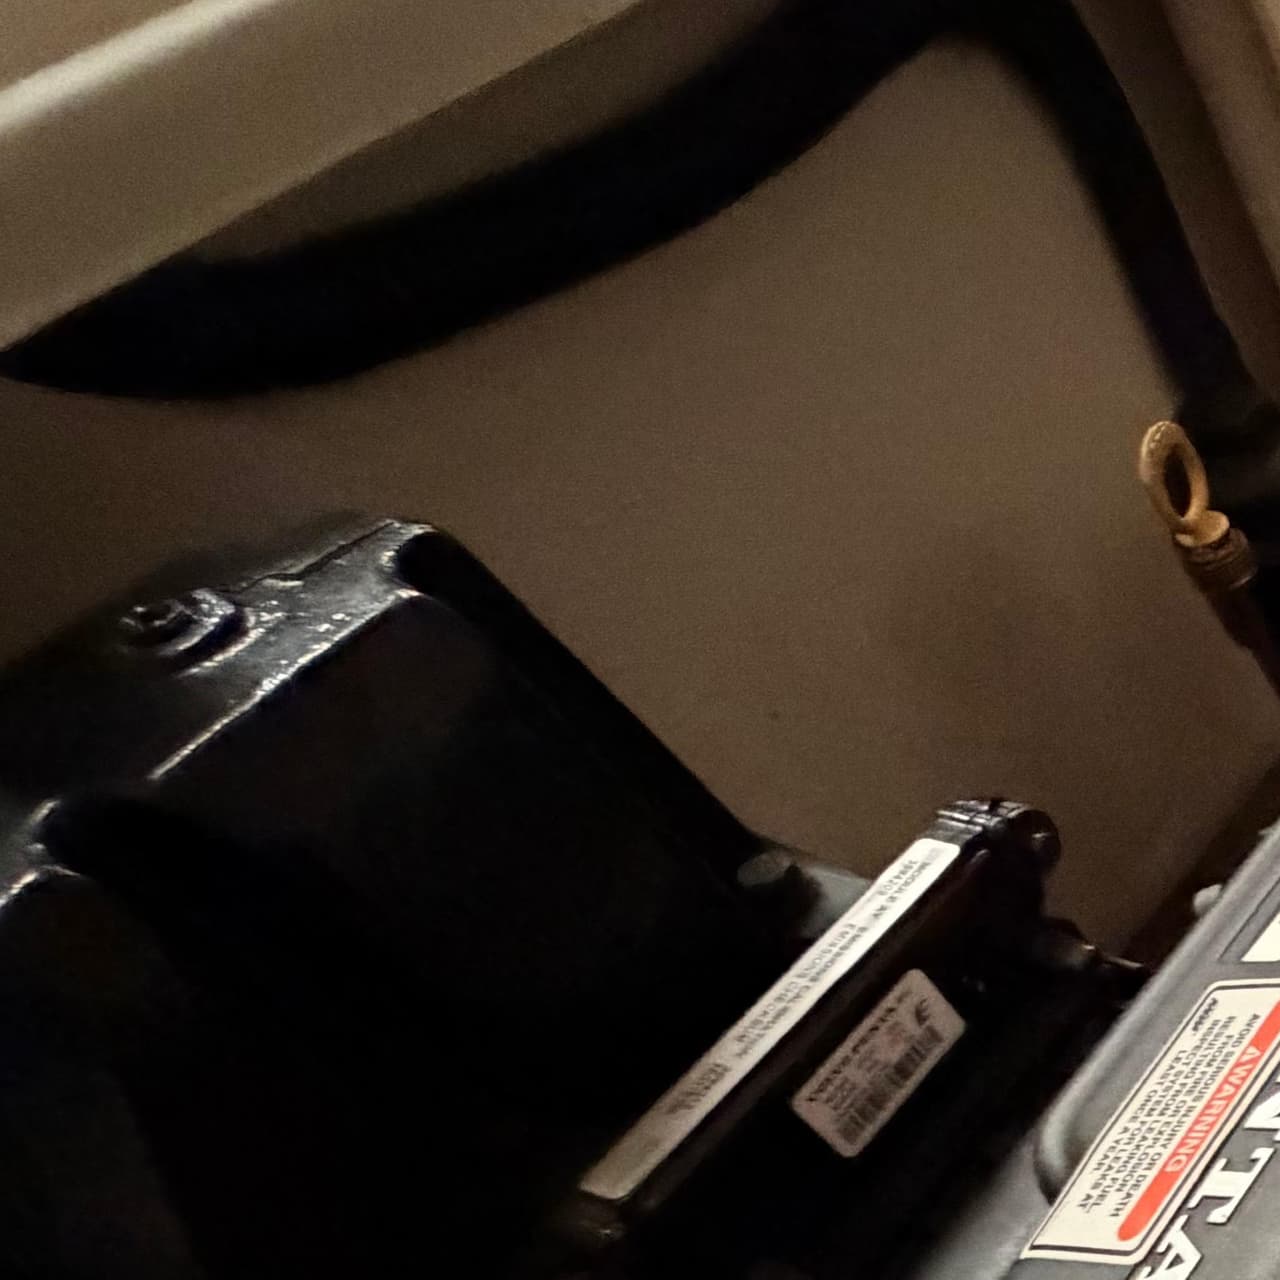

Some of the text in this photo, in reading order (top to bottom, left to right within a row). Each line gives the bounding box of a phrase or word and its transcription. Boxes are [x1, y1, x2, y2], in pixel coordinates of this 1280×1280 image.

[1153, 1050, 1188, 1085] LEAST
[1183, 1016, 1236, 1078] RESULTING
[1203, 1035, 1235, 1066] FROM
[1076, 1019, 1222, 1207] INSPECT SYSTEM FOR LEAKS AT
[1108, 1013, 1262, 1217] AVOID SERIOUS INJURY OR DEATH
[1126, 1089, 1159, 1122] ONCE
[1156, 1083, 1188, 1116] FROM
[1161, 1065, 1253, 1172] WARNING
[1113, 1121, 1173, 1192] EXPLOSION
[1114, 1120, 1161, 1173] LEAKING
